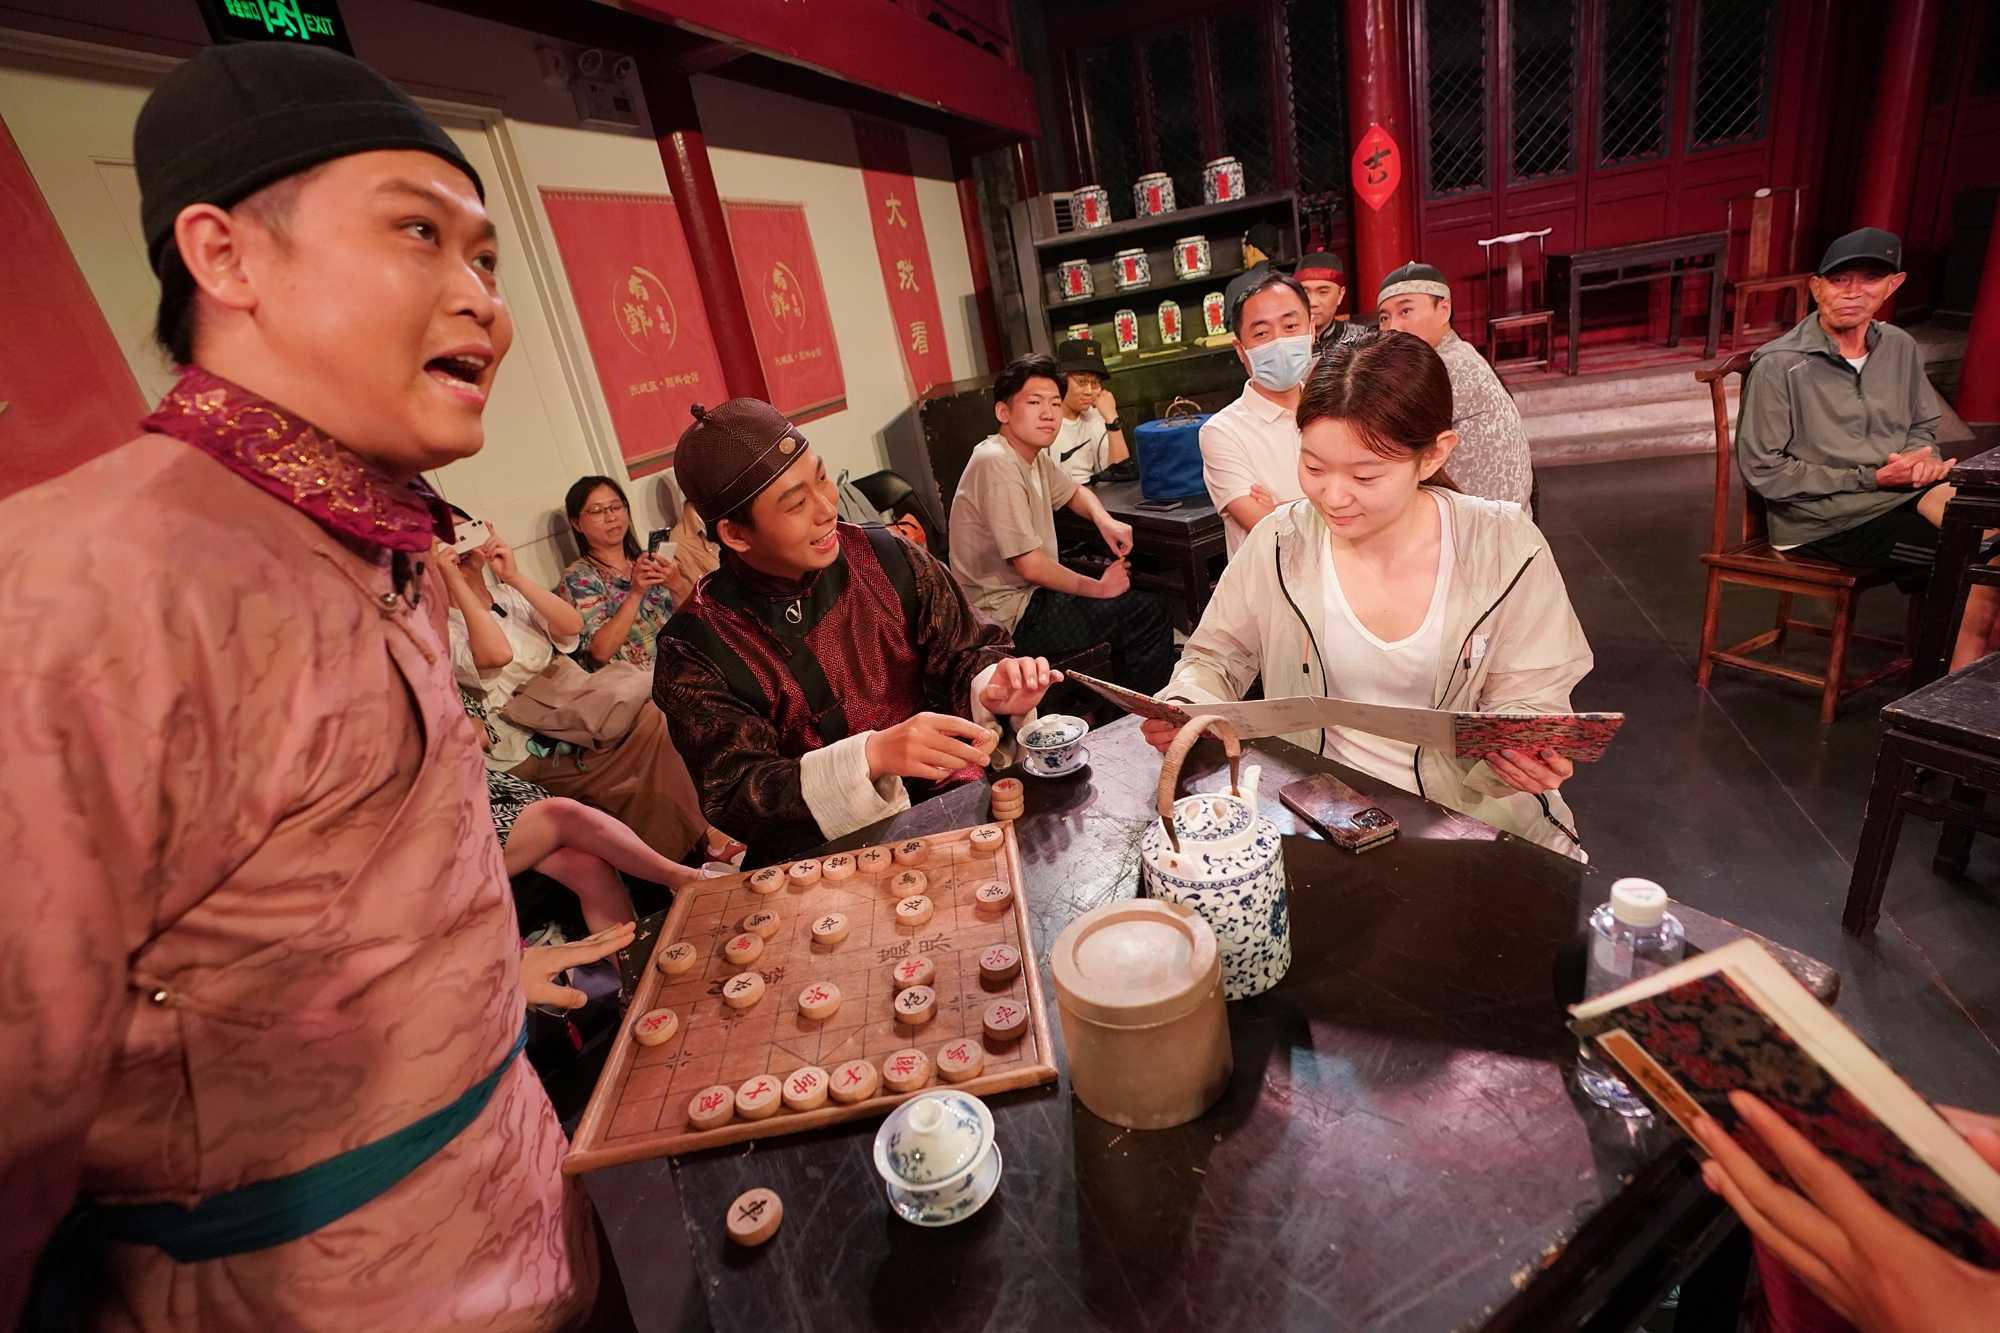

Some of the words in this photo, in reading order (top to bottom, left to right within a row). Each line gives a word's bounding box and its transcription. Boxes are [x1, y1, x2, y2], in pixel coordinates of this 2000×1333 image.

[303, 13, 335, 36] EXIT
[885, 192, 933, 395] 大戏看
